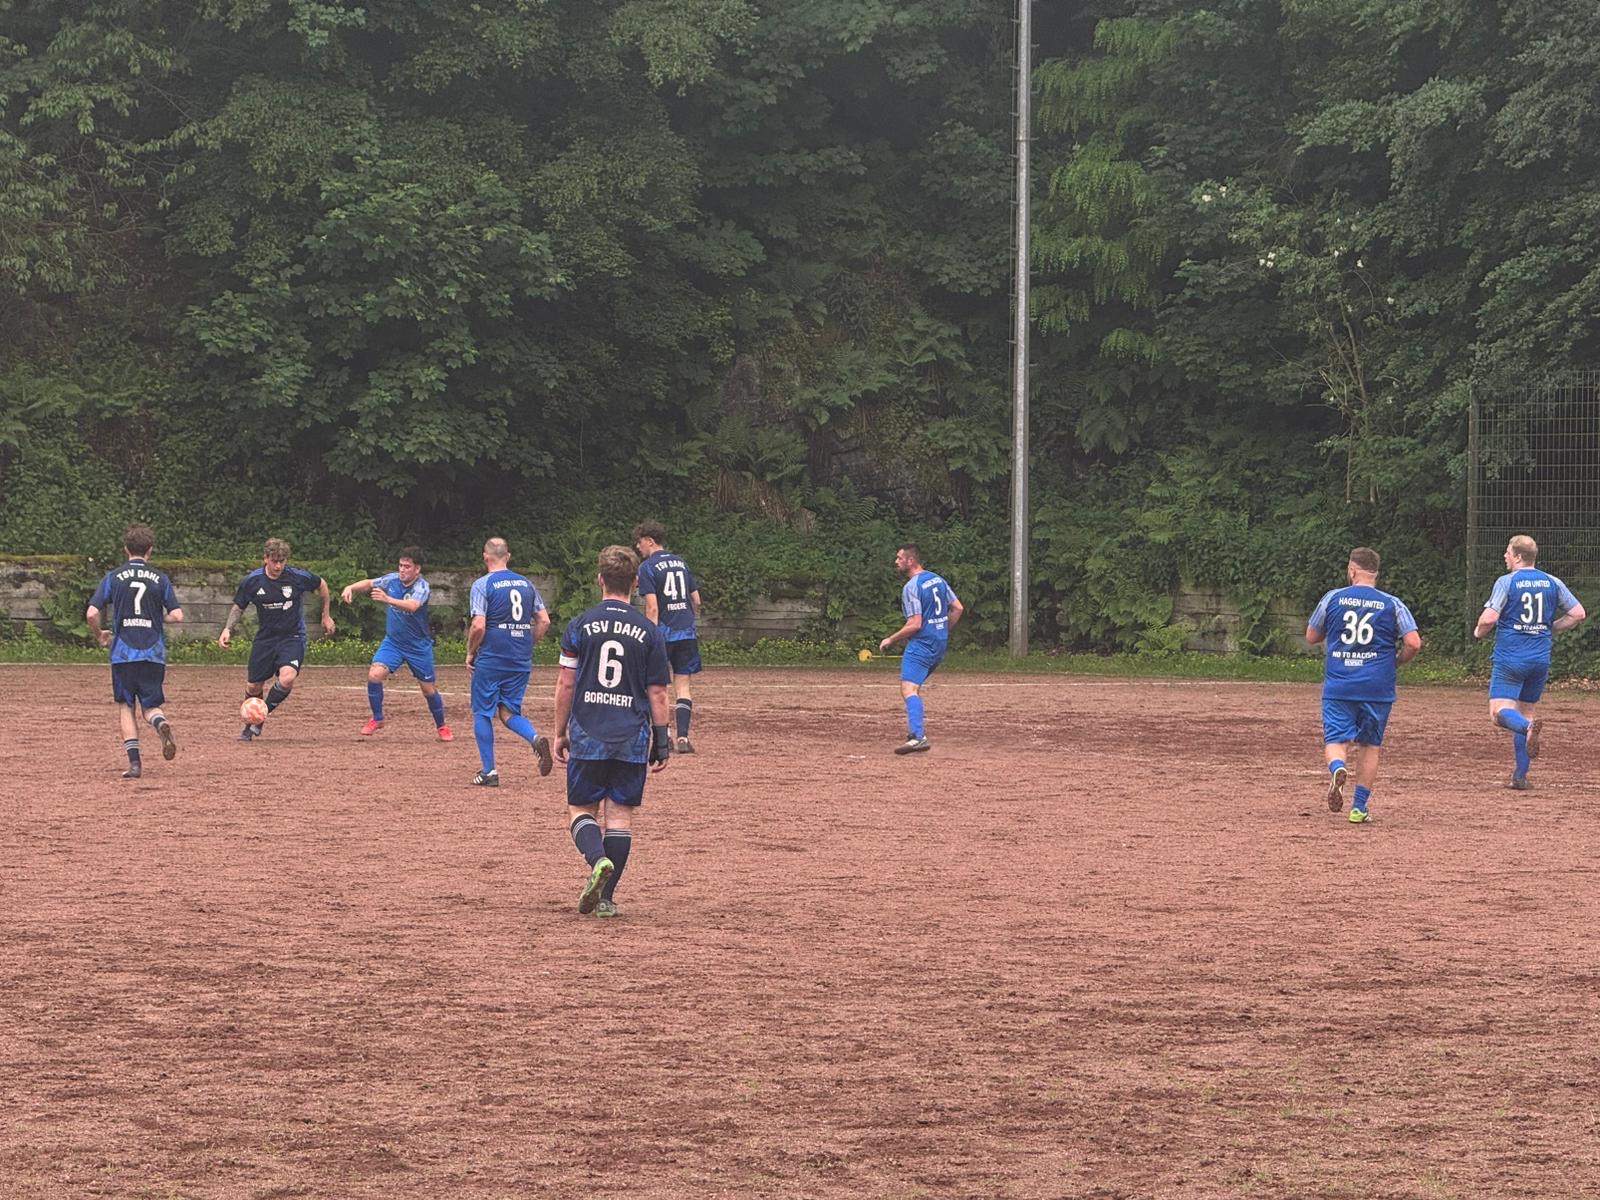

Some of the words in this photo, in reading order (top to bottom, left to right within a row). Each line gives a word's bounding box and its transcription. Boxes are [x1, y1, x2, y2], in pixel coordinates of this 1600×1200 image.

[116, 569, 135, 581] TSV
[137, 569, 160, 584] DAHL
[663, 570, 687, 600] 41
[129, 581, 147, 615] 7
[510, 589, 523, 621] 8
[932, 586, 942, 616] 5
[1339, 597, 1361, 607] HAGEN
[1362, 599, 1385, 610] UNITED
[1520, 591, 1543, 624] 31
[583, 620, 609, 637] TSV
[613, 621, 647, 643] DAHL
[1341, 610, 1375, 646] 36
[598, 640, 625, 688] 6
[1332, 650, 1341, 658] NO
[1342, 651, 1351, 659] TO
[584, 691, 634, 707] BORCHERT
